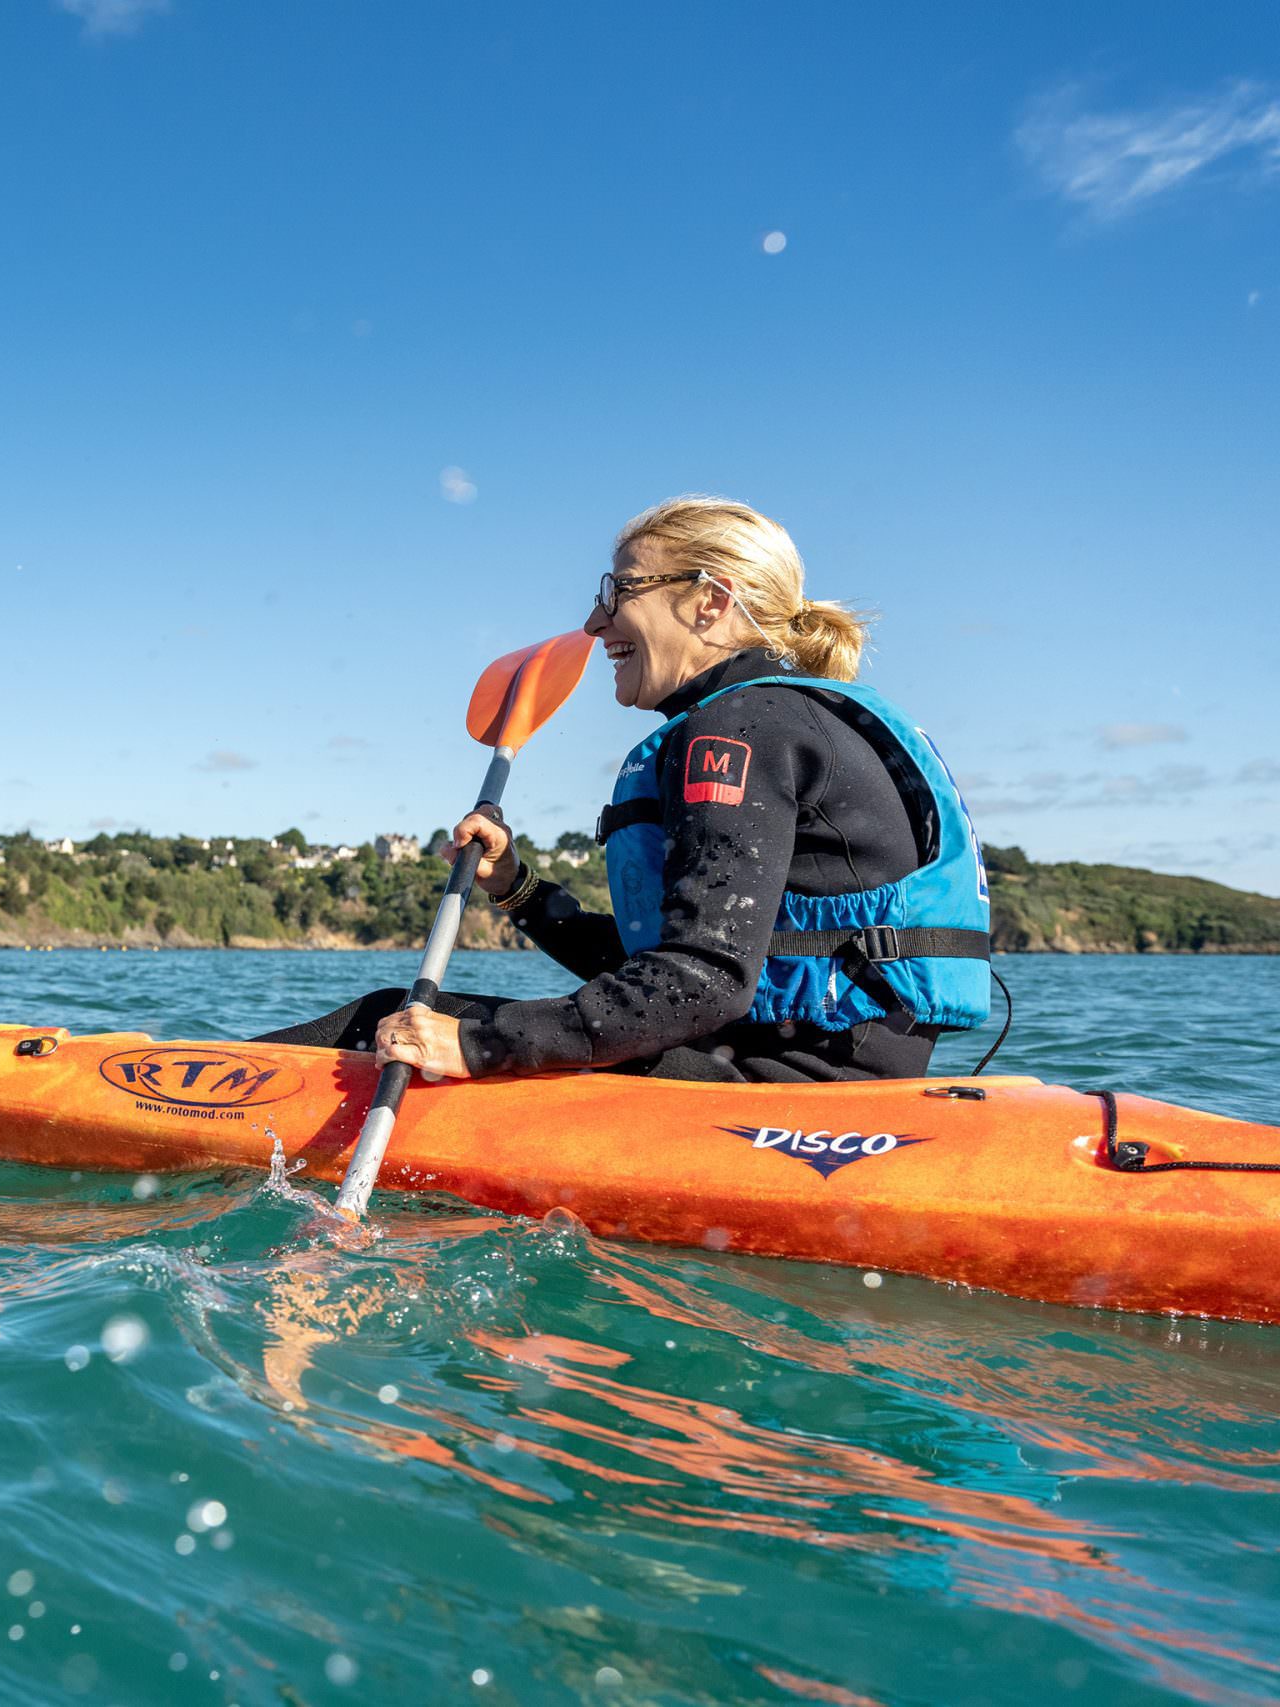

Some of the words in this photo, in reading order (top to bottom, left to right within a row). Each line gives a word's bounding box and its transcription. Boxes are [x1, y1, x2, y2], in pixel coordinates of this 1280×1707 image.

[703, 750, 730, 774] M
[115, 1061, 281, 1096] RTM
[135, 1101, 245, 1120] www.rotomod.com
[752, 1127, 897, 1155] DISCO
